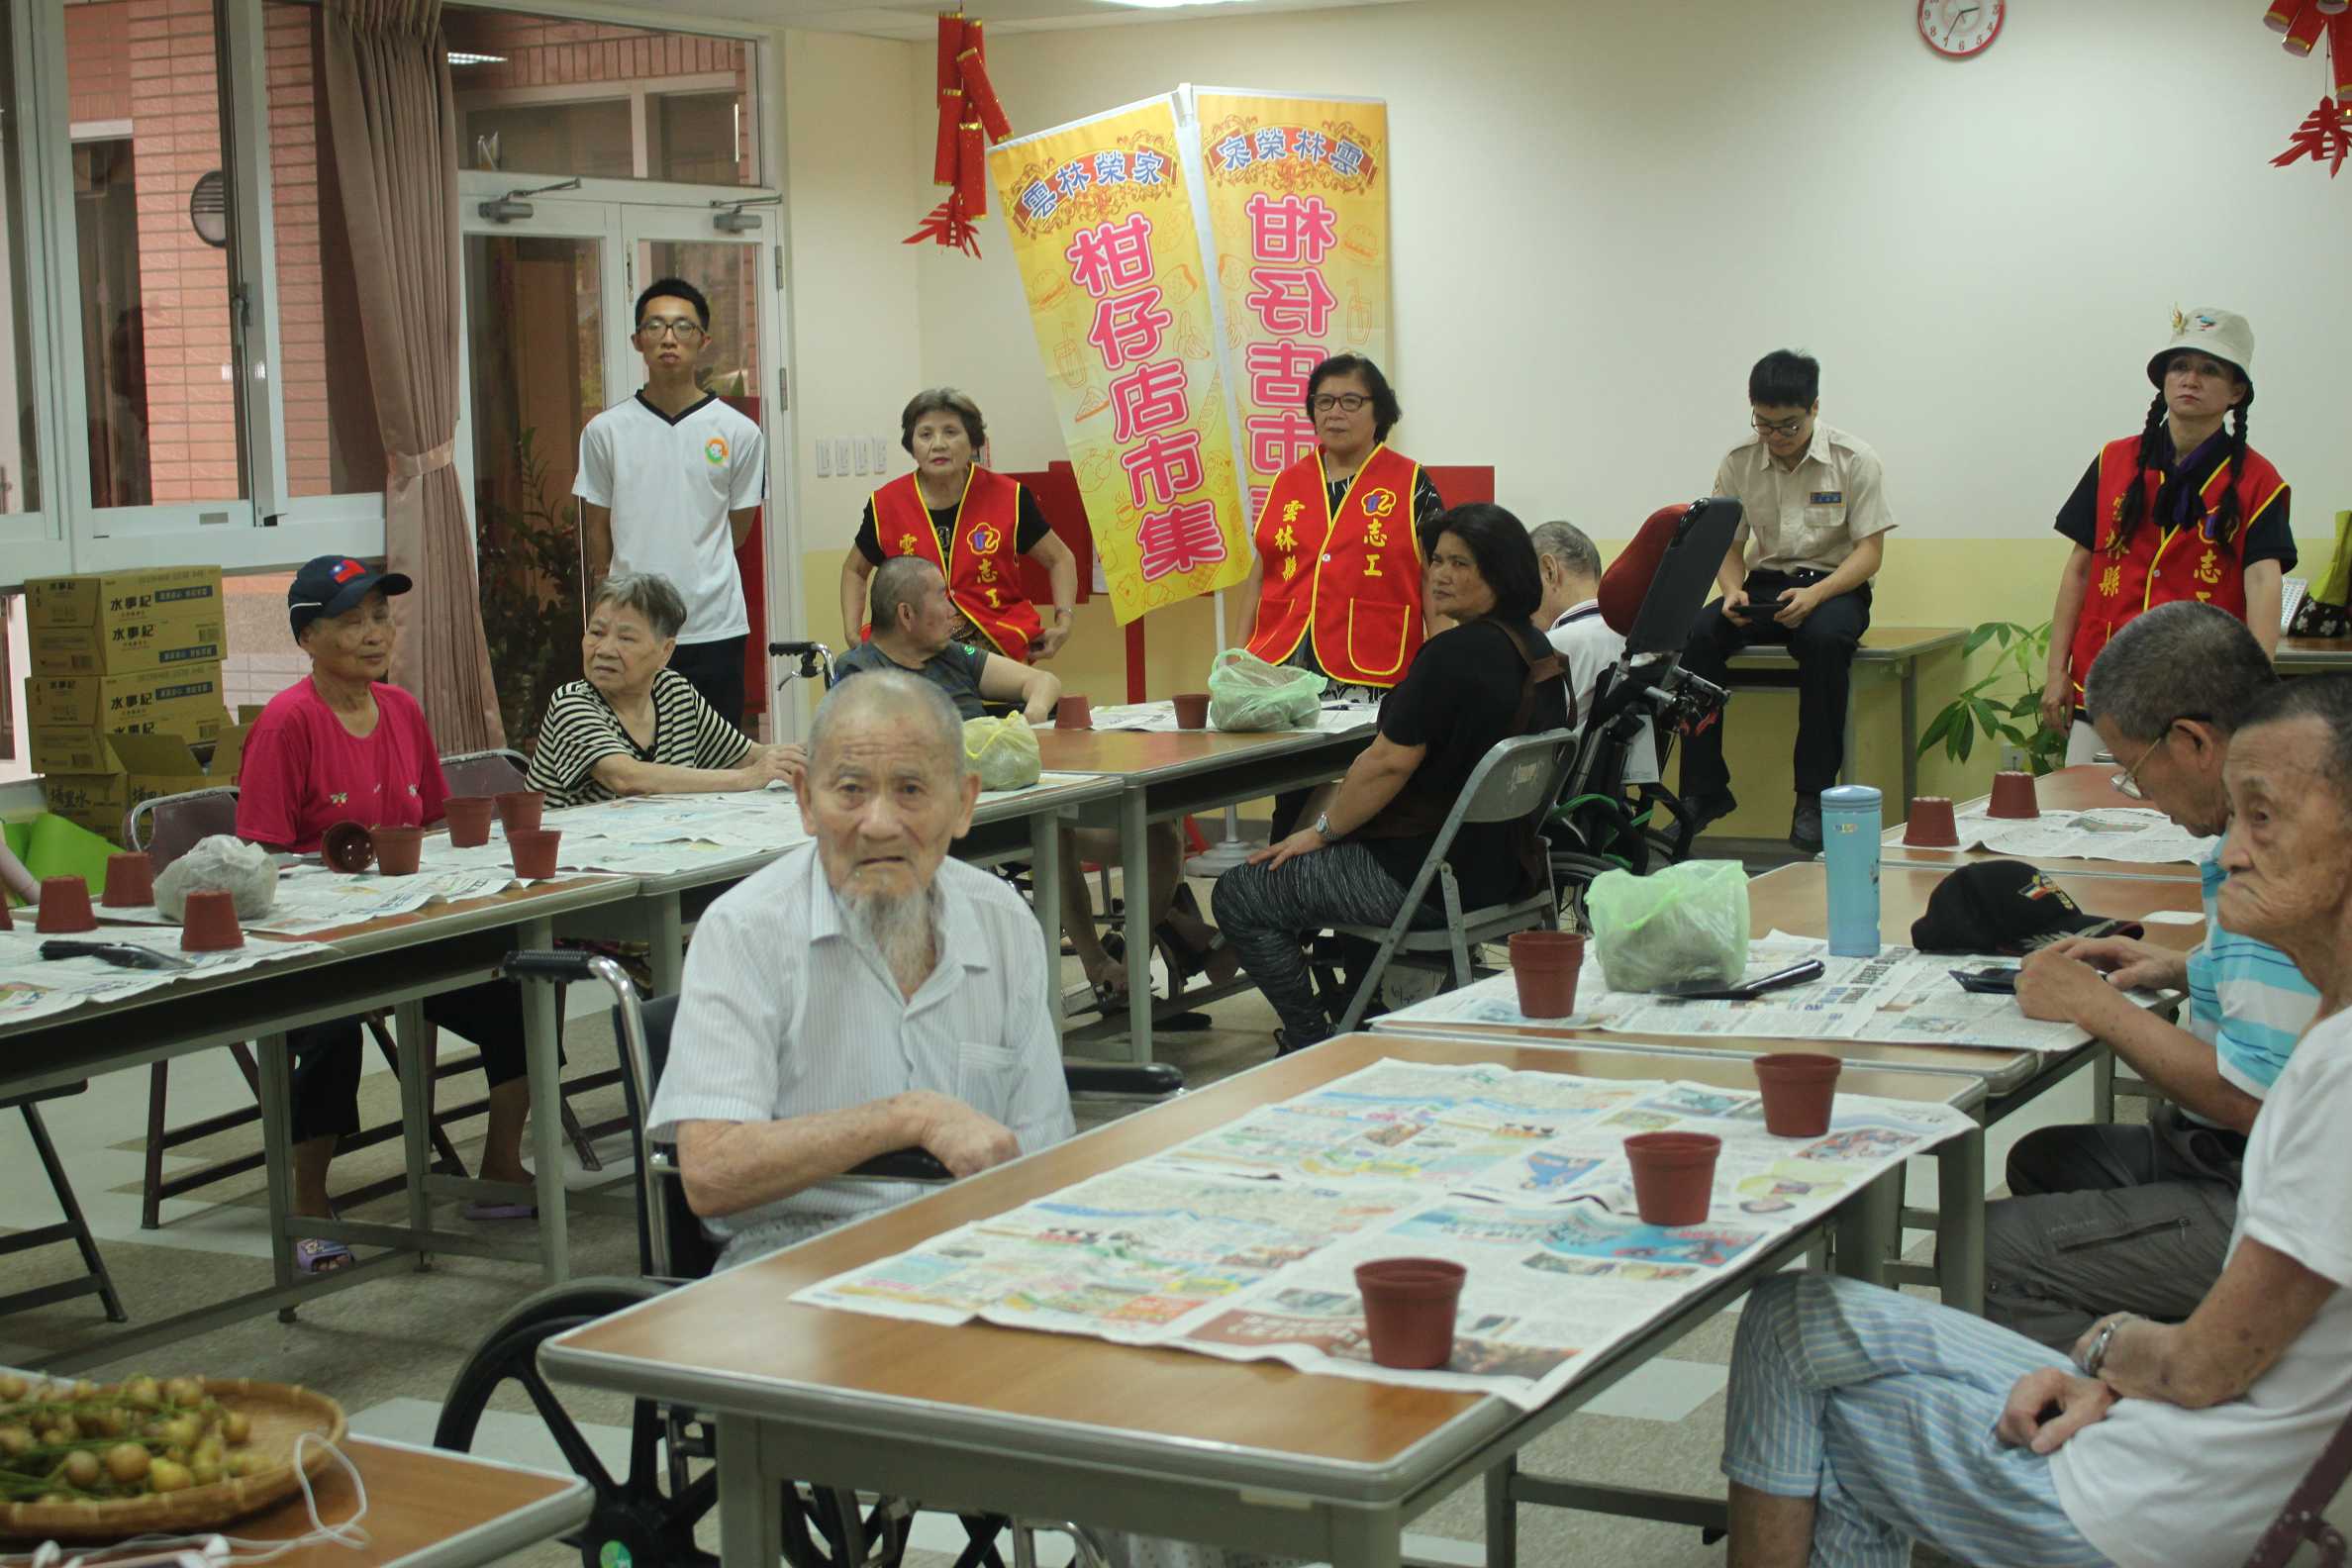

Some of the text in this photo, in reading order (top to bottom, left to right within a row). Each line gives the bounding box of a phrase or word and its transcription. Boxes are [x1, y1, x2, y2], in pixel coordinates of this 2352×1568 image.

[1019, 149, 1166, 221] 雲林榮家
[1066, 211, 1226, 584] 柑仔店市集
[1362, 519, 1388, 577] 志工
